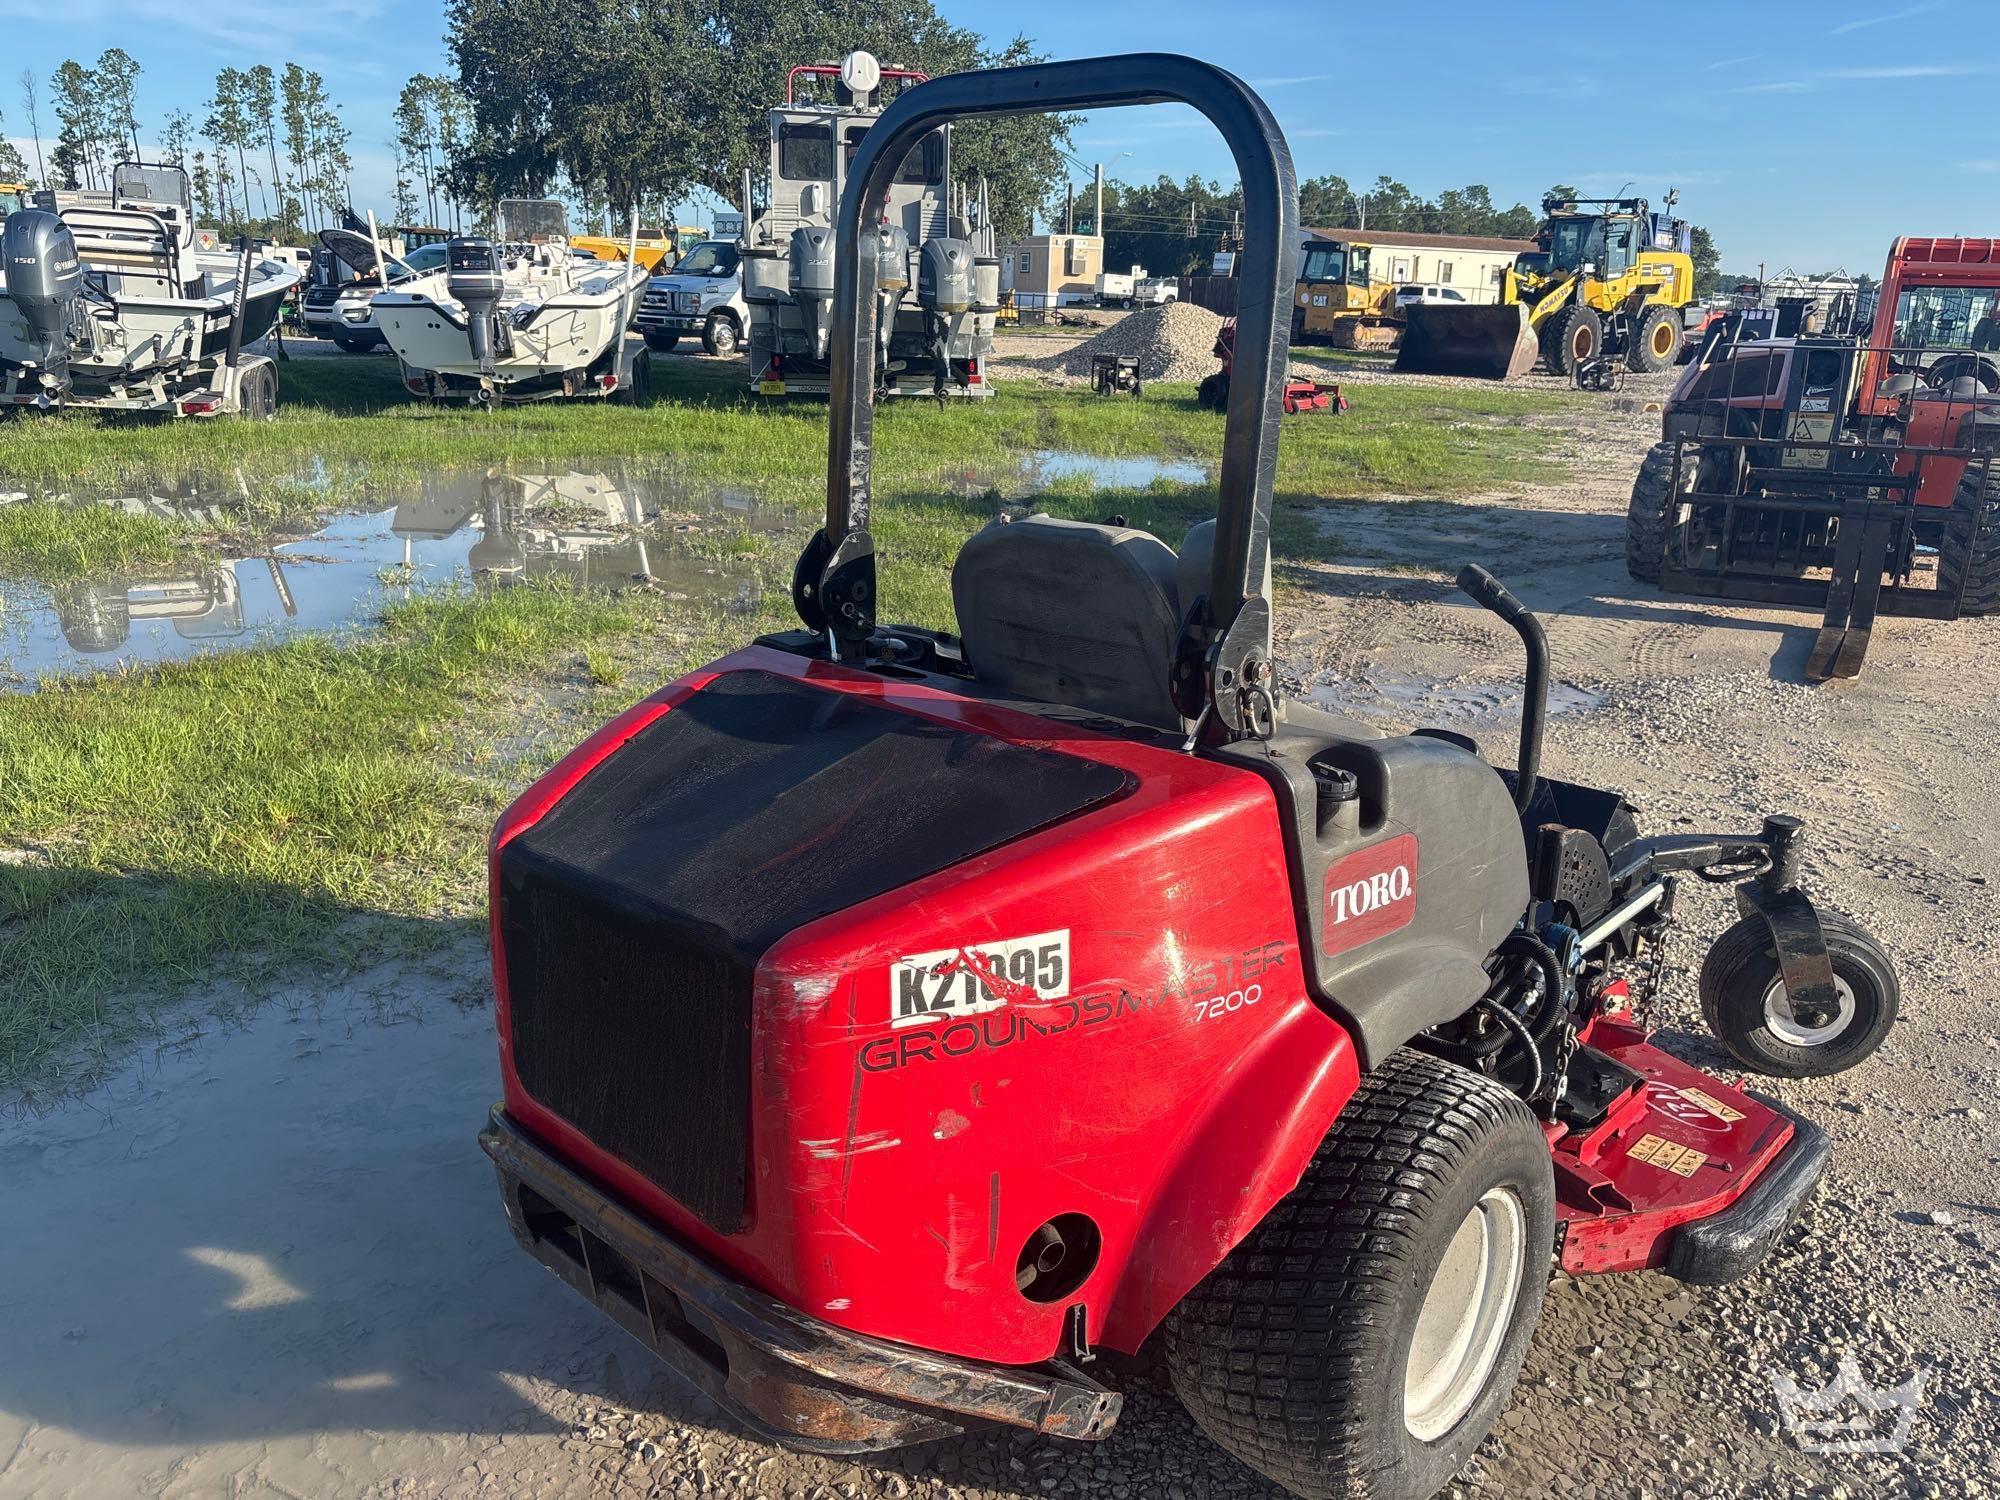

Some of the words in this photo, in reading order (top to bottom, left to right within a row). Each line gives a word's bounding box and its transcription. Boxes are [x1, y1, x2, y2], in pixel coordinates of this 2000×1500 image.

[1313, 295, 1328, 307] CAT
[1539, 286, 1569, 313] KOMATSU
[1331, 865, 1411, 925] TORO
[860, 940, 1287, 1072] GROUNDSMASTER
[1194, 984, 1262, 1022] 7200
